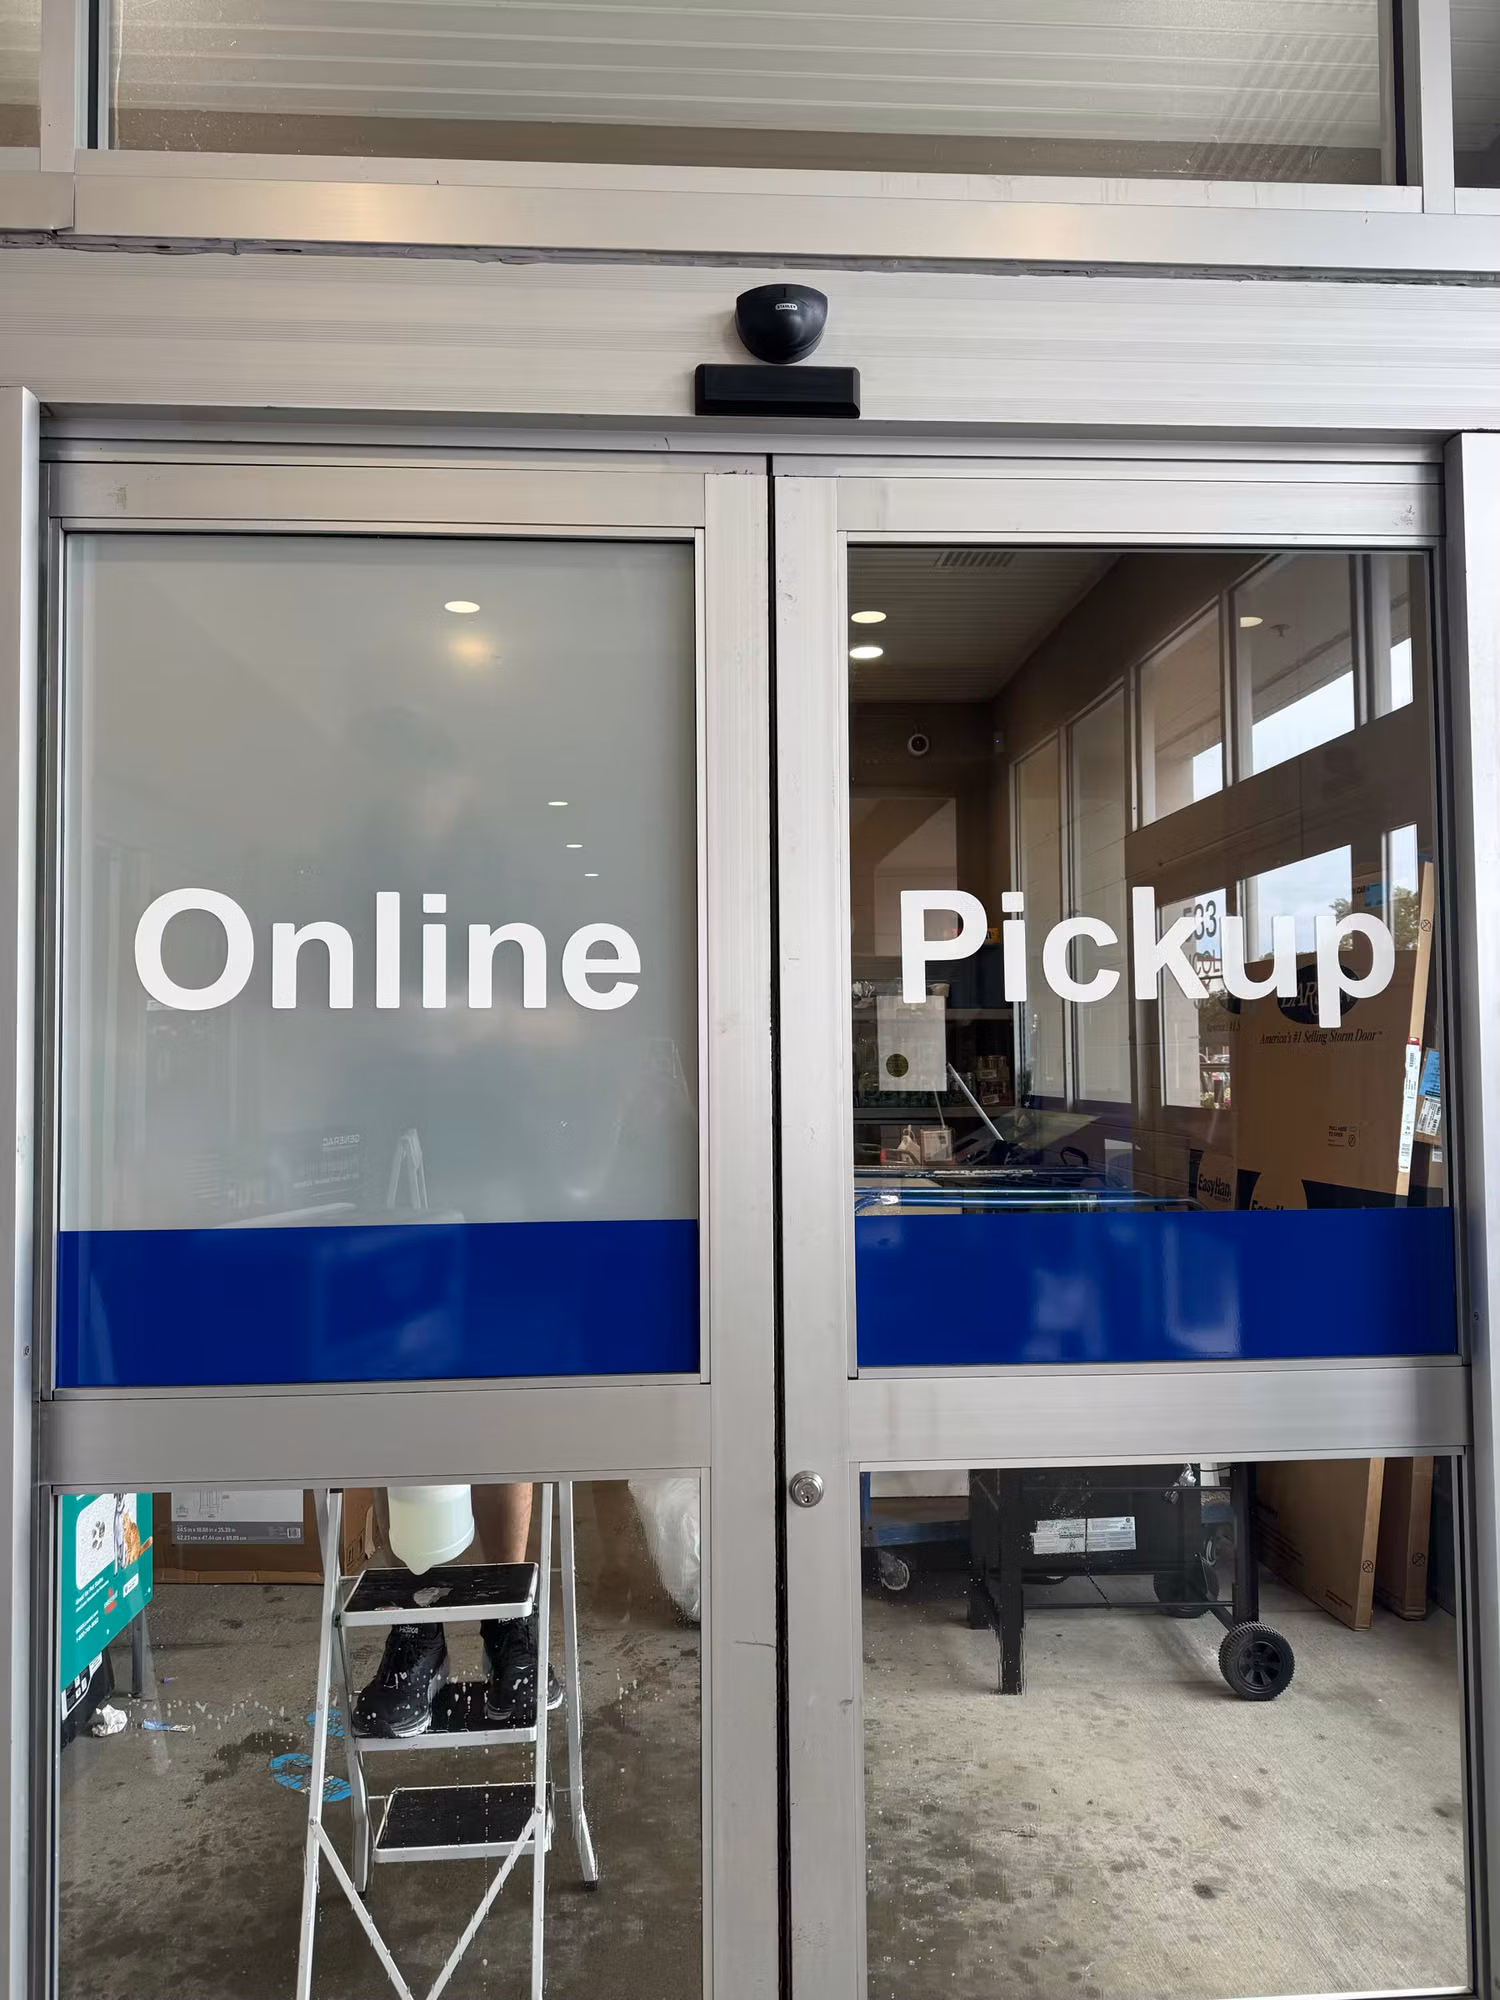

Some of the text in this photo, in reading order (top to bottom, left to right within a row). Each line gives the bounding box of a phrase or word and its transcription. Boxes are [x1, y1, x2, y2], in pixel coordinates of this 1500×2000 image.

[134, 886, 1396, 1029] Online Pickup
[1261, 1031, 1292, 1045] America's
[1303, 1030, 1328, 1046] Selling
[1329, 1029, 1354, 1042] Storm
[1198, 1173, 1232, 1197] EasyHan
